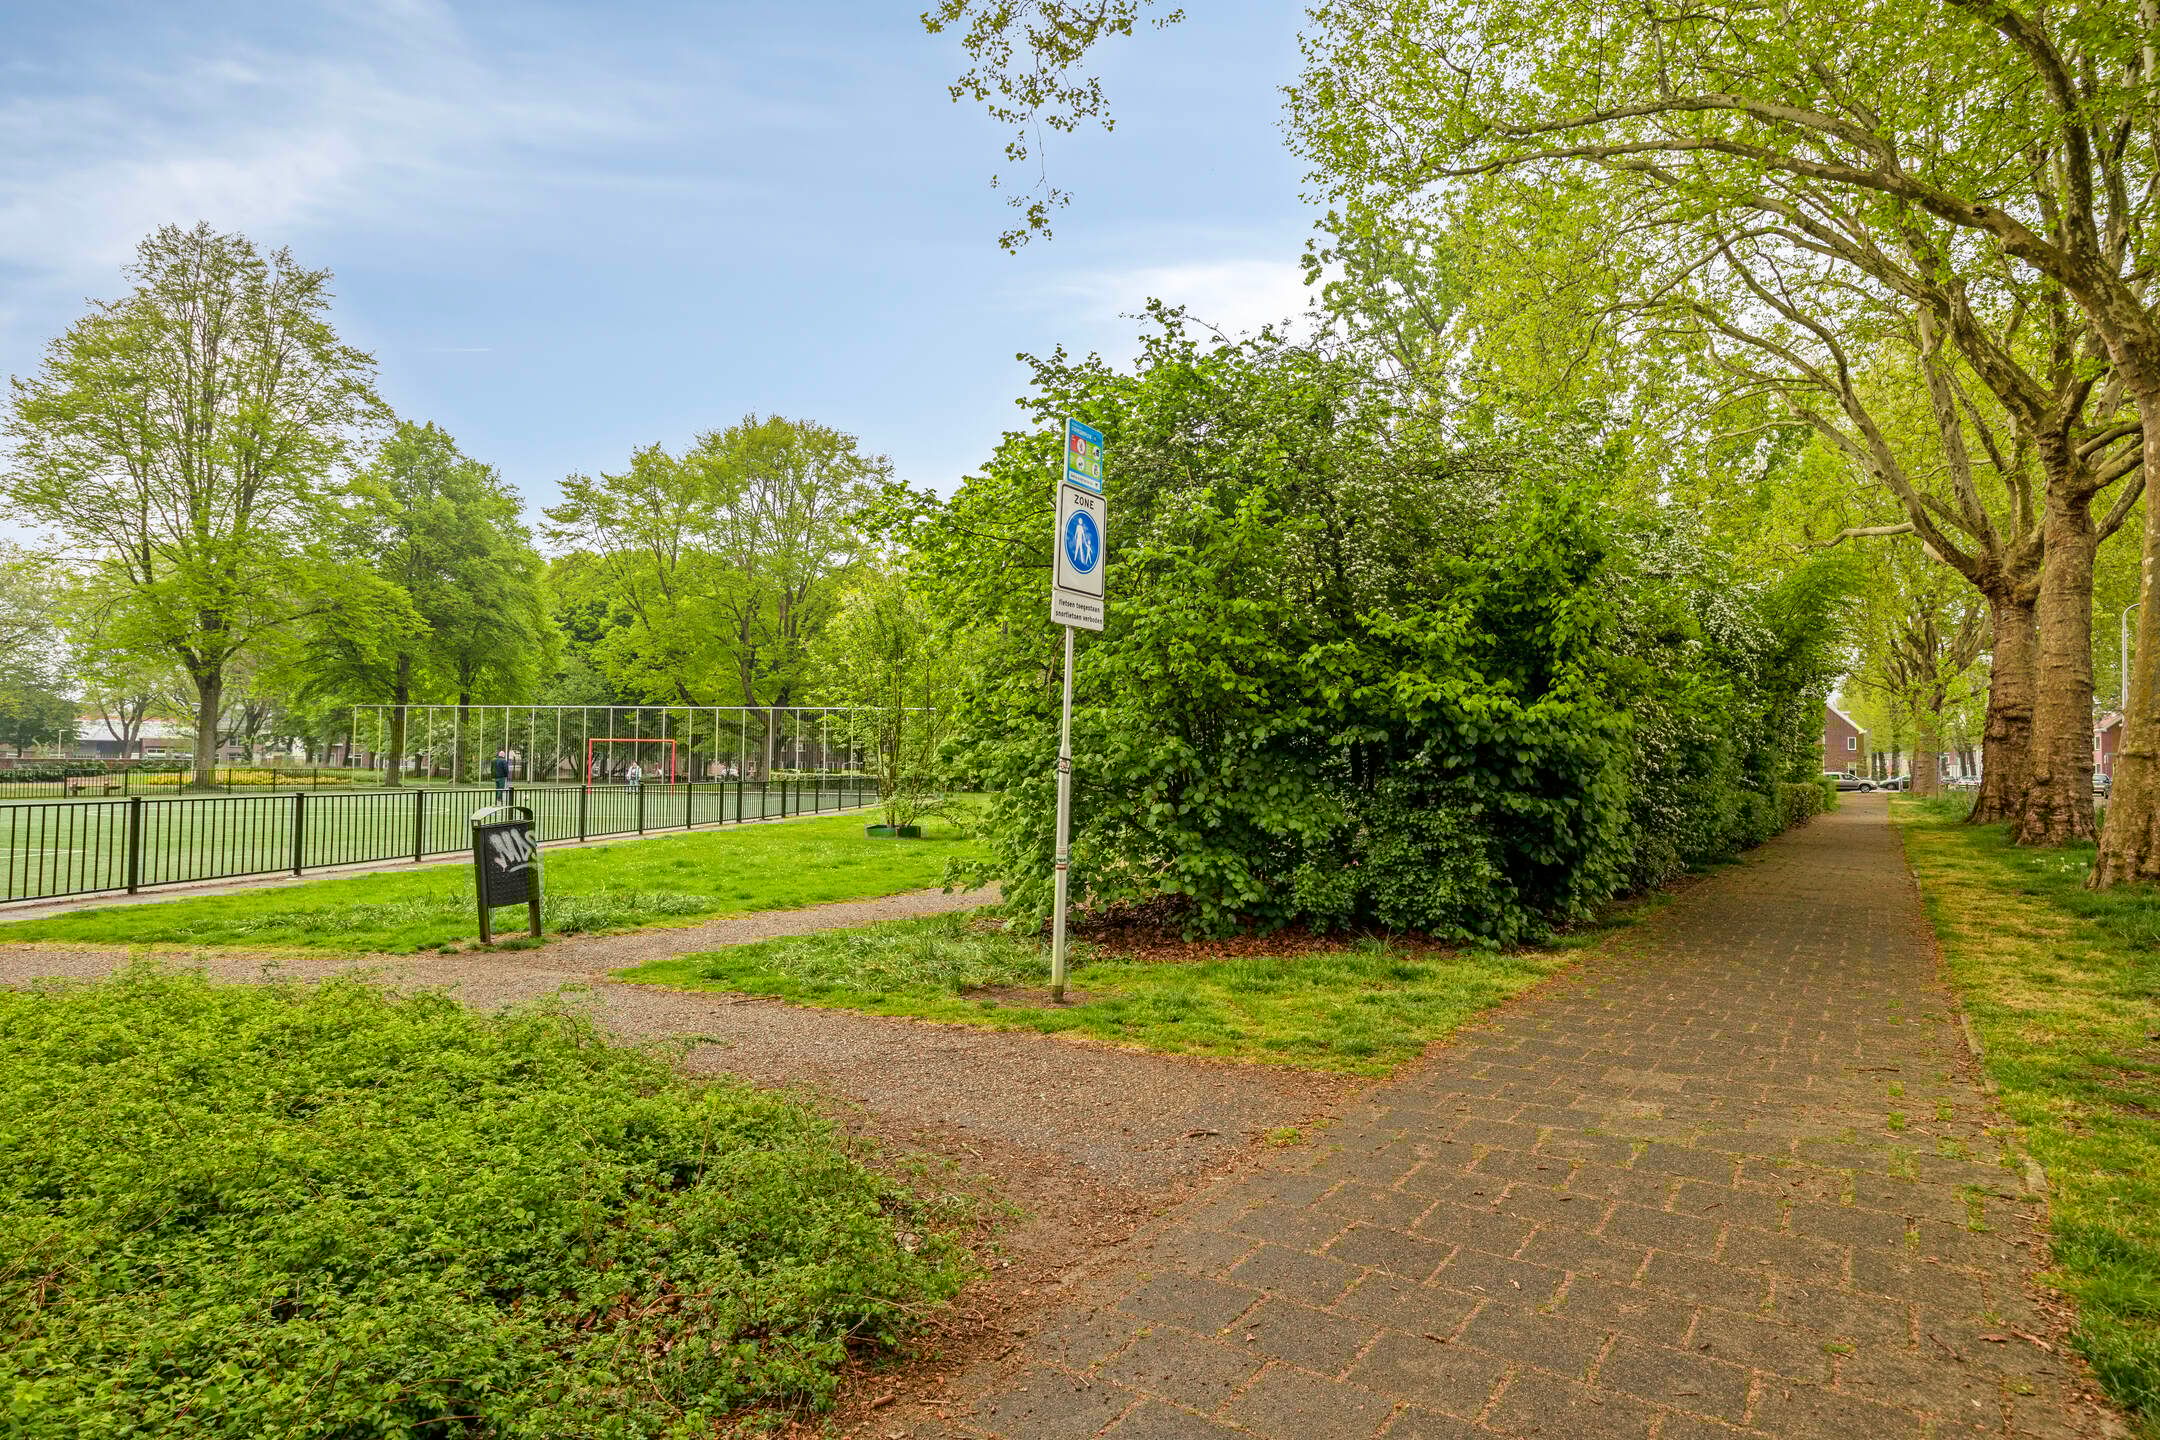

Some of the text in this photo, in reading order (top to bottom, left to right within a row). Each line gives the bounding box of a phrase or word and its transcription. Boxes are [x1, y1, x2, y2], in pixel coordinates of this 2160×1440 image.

[1074, 494, 1094, 510] ZONE
[1076, 603, 1100, 612] toegestaan
[1083, 616, 1102, 624] verboden
